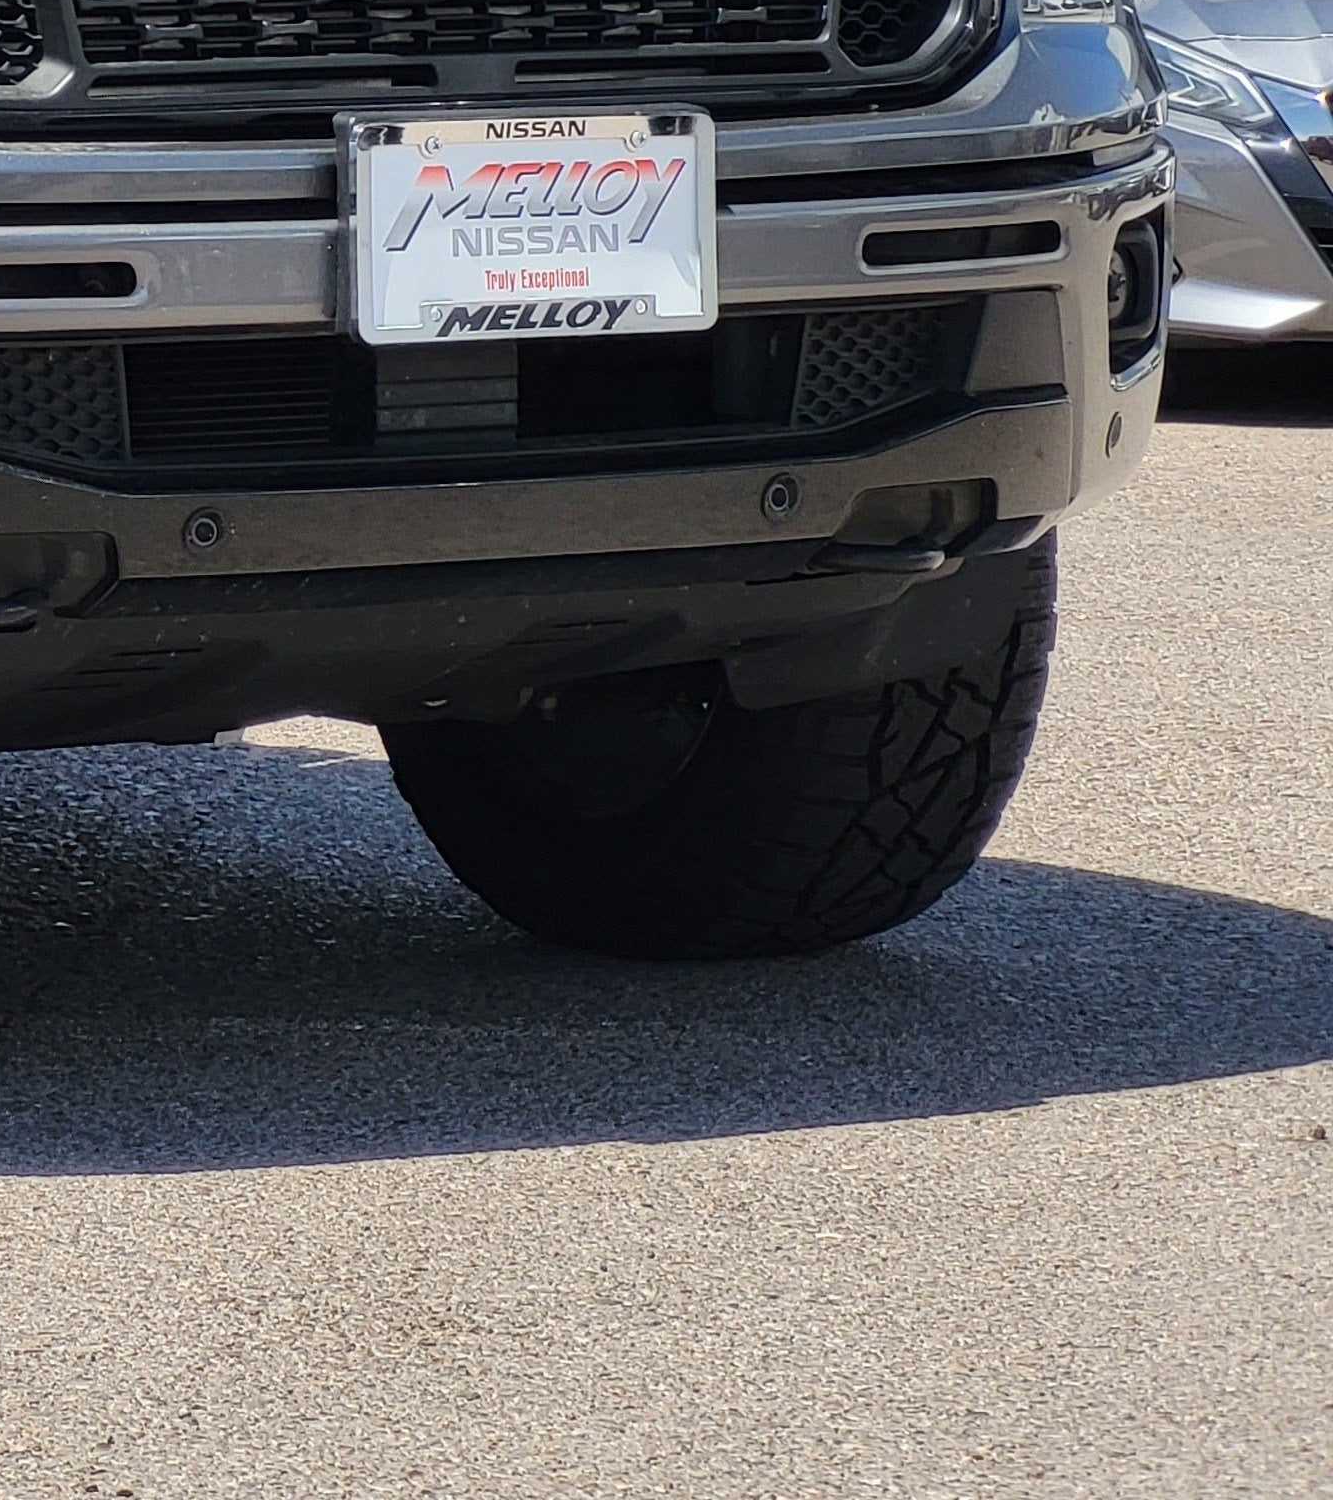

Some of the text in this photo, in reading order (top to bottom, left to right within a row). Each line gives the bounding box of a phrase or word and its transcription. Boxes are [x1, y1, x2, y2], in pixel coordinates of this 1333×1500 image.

[485, 119, 587, 140] NISSAN
[383, 158, 687, 252] MELLOY
[451, 223, 619, 258] NISSAN
[484, 266, 590, 293] Truly Exceptional
[435, 299, 635, 338] MELLOY
